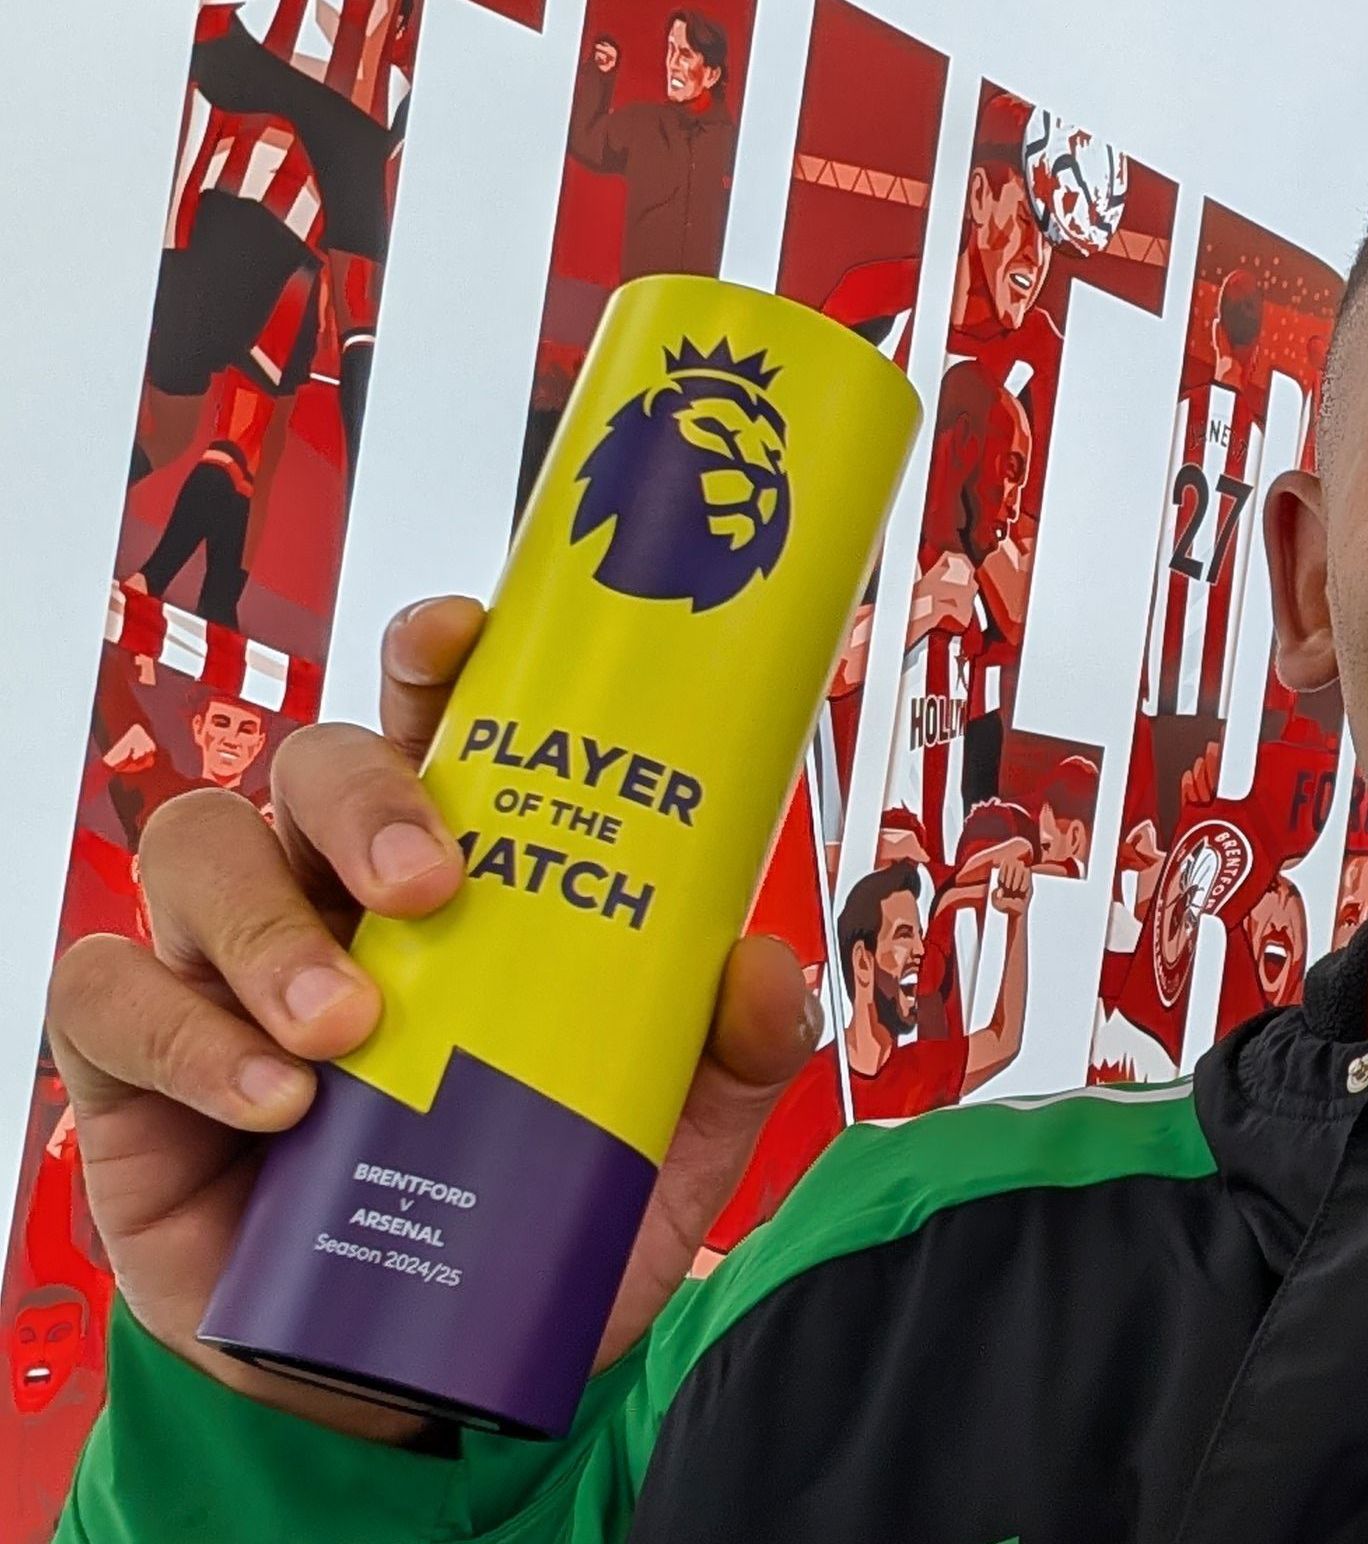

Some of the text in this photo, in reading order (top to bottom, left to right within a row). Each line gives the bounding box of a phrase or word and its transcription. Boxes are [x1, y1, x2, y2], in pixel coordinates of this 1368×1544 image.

[1168, 462, 1254, 587] 27
[458, 718, 703, 827] PLAYER
[494, 788, 623, 844] OF THE
[353, 1162, 477, 1209] BRENTFORD
[349, 1208, 445, 1248] ARSENAL
[314, 1232, 463, 1287] Season 2024/25
